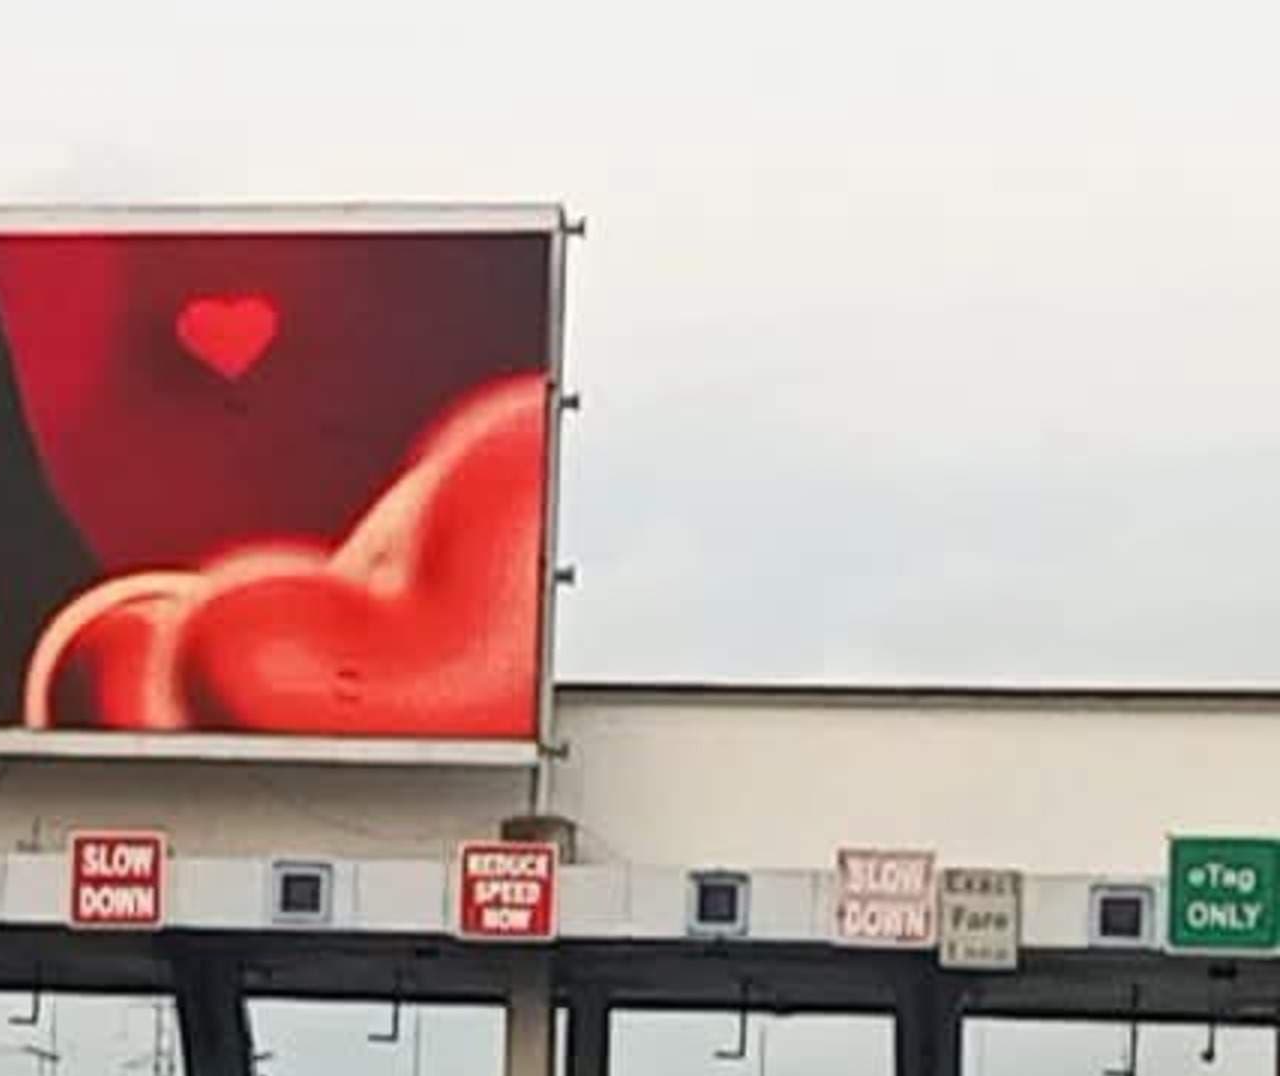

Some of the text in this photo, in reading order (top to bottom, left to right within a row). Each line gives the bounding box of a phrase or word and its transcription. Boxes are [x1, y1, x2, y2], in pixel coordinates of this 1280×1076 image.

[81, 844, 154, 878] SLOW
[467, 852, 549, 878] REDUCE
[846, 860, 924, 894] SLOW
[474, 880, 542, 905] SPEED
[1188, 865, 1256, 893] eTag
[78, 885, 155, 920] DOWN
[1186, 901, 1263, 931] ONLY
[845, 901, 925, 937] DOWN
